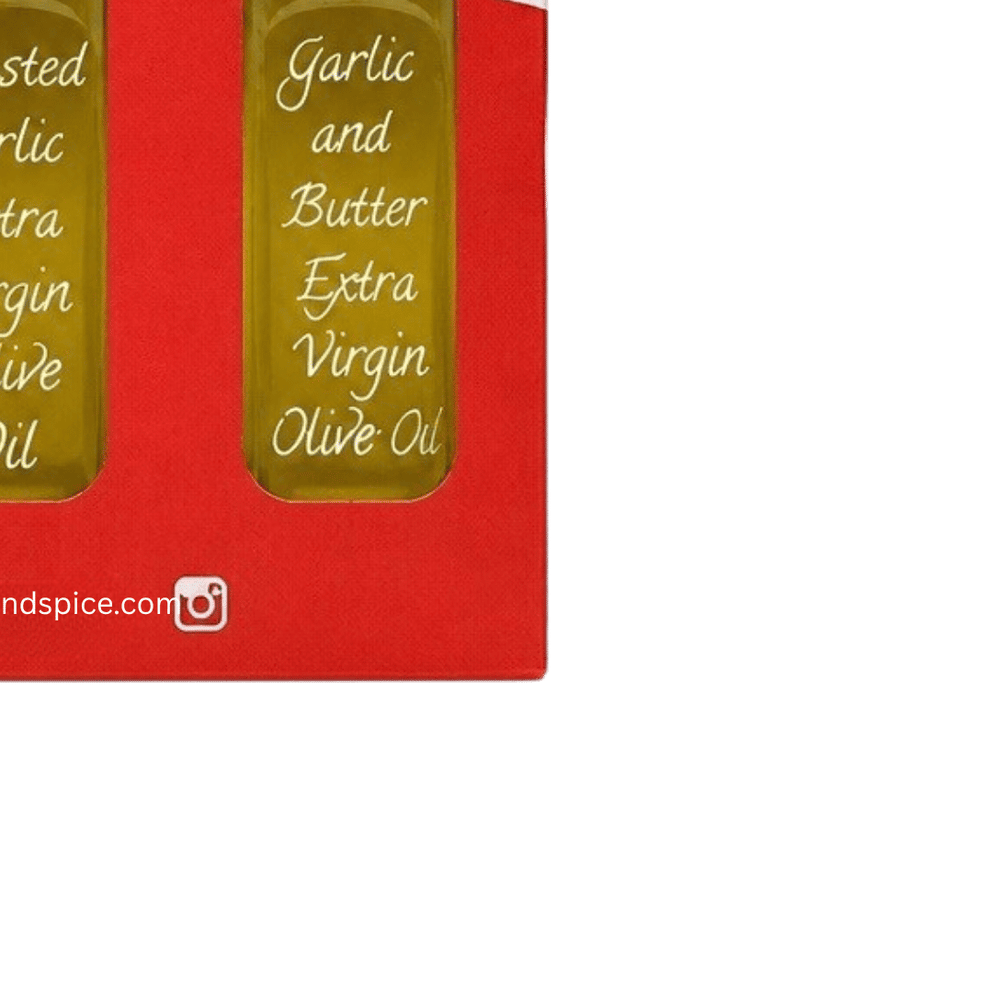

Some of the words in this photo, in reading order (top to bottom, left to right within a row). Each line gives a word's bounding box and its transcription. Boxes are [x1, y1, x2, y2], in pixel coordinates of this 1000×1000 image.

[276, 34, 415, 112] Garlic
[310, 109, 393, 154] and
[281, 181, 428, 227] Butter
[296, 252, 419, 321] Extra
[292, 329, 429, 402] Virgin
[272, 405, 376, 457] Olive
[391, 405, 444, 457] Oil
